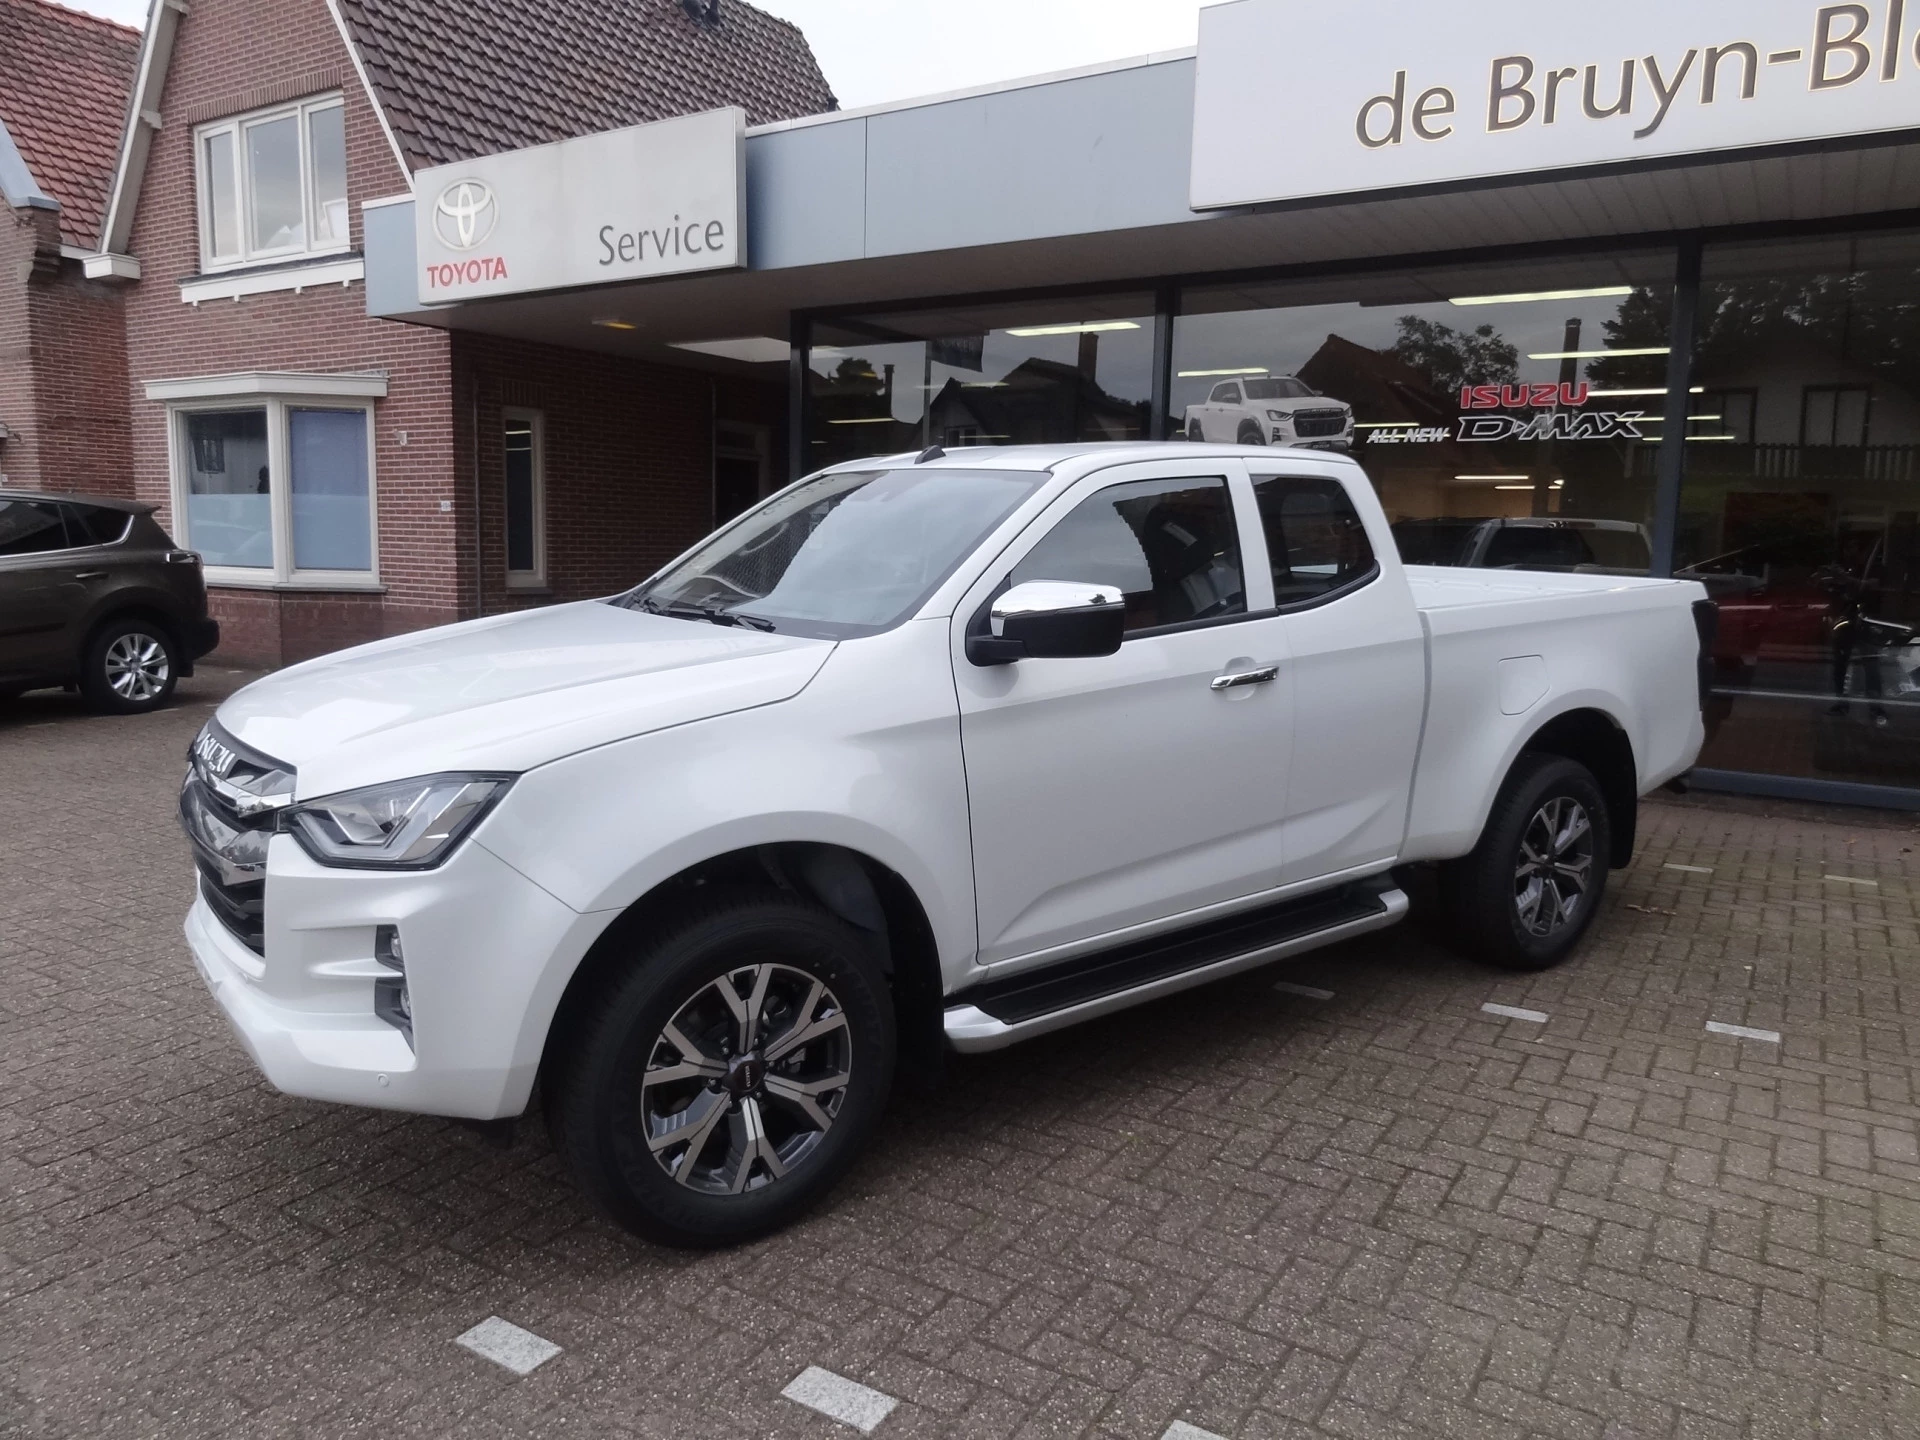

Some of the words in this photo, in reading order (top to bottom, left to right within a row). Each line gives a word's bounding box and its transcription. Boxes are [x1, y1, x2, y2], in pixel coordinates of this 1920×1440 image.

[1355, 69, 1456, 149] de
[599, 214, 725, 266] Service
[427, 257, 508, 288] TOYOTA
[1460, 382, 1589, 409] ISUZU
[1366, 428, 1400, 444] ALL
[1403, 427, 1450, 443] NEW
